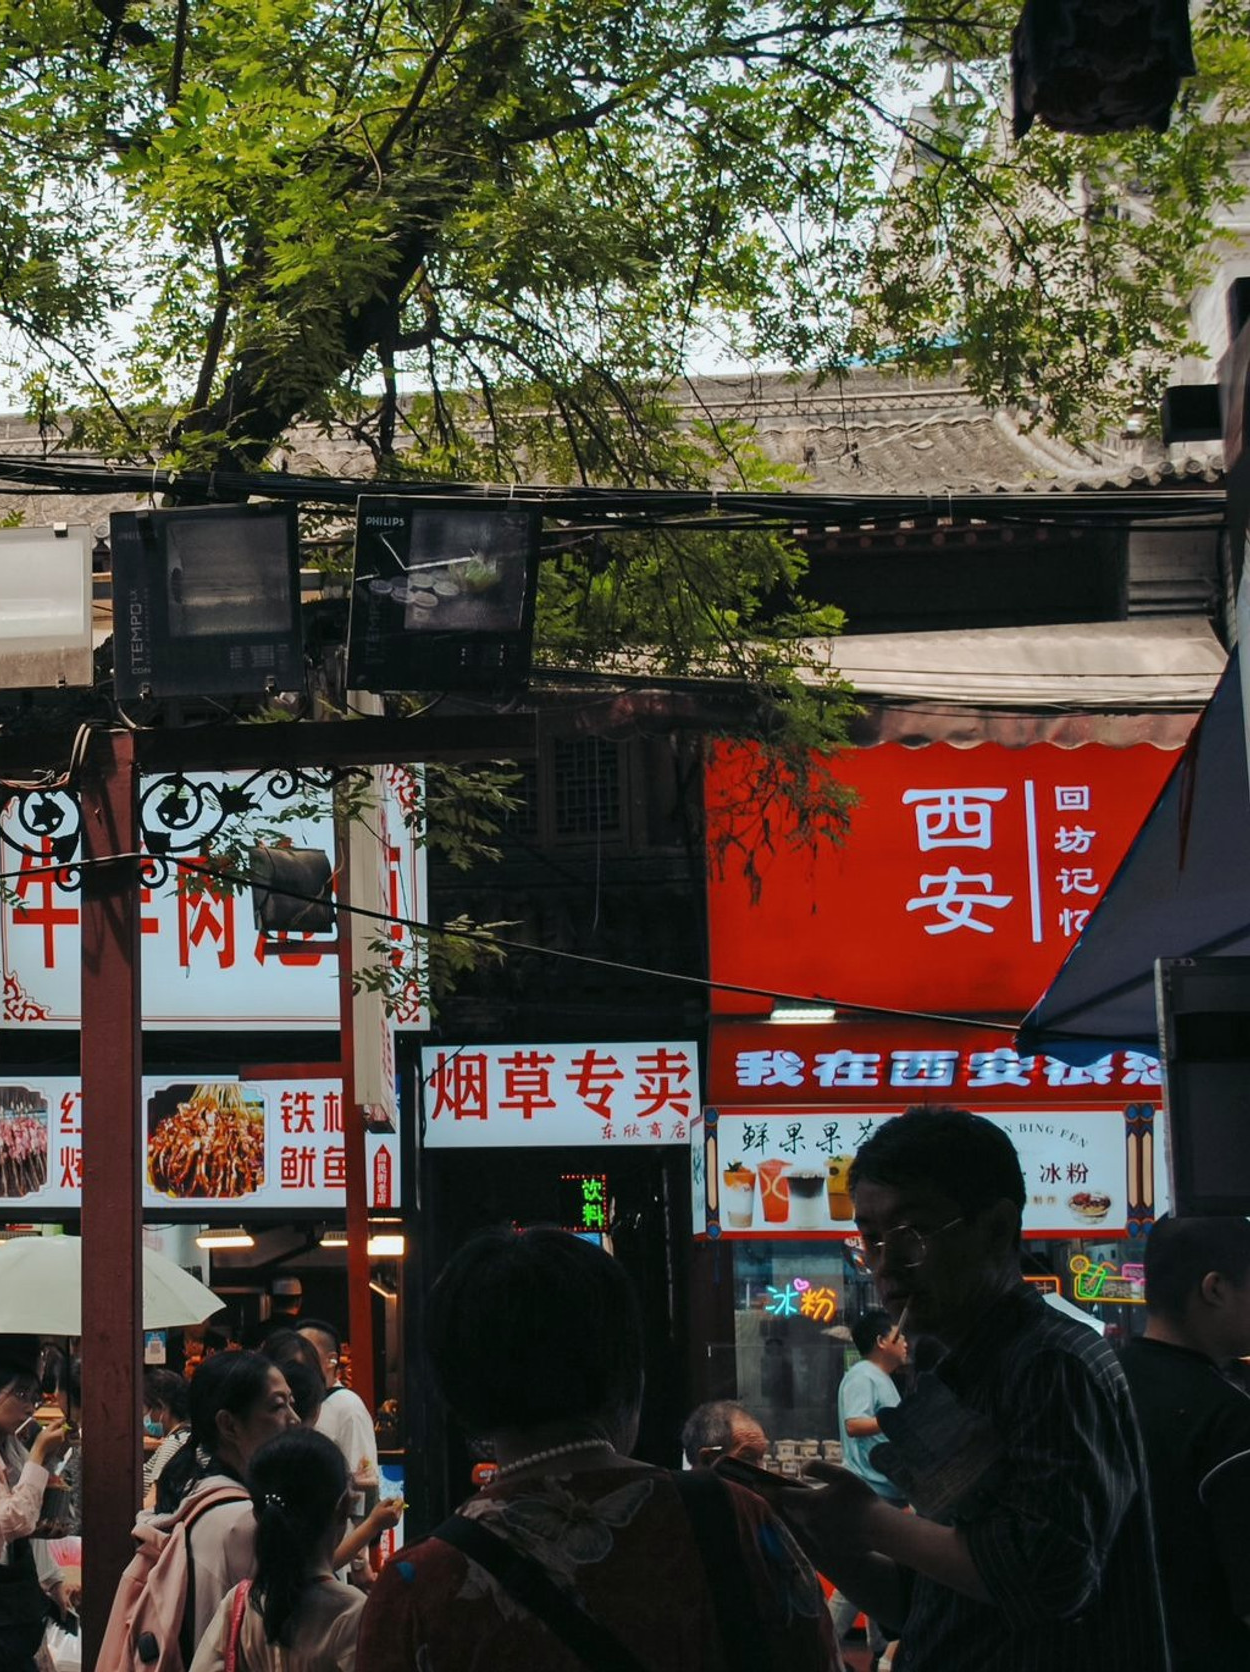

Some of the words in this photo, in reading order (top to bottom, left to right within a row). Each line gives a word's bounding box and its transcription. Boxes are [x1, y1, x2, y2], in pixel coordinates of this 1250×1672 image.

[365, 516, 405, 526] PHILIPS
[902, 787, 1014, 935] 西安
[430, 1048, 693, 1121] 烟草专卖
[1019, 1123, 1054, 1135] BING
[1060, 1129, 1089, 1149] FEN
[1040, 1162, 1089, 1184] 冰粉
[582, 1178, 604, 1227] 饮料
[765, 1285, 837, 1323] 冰粉
